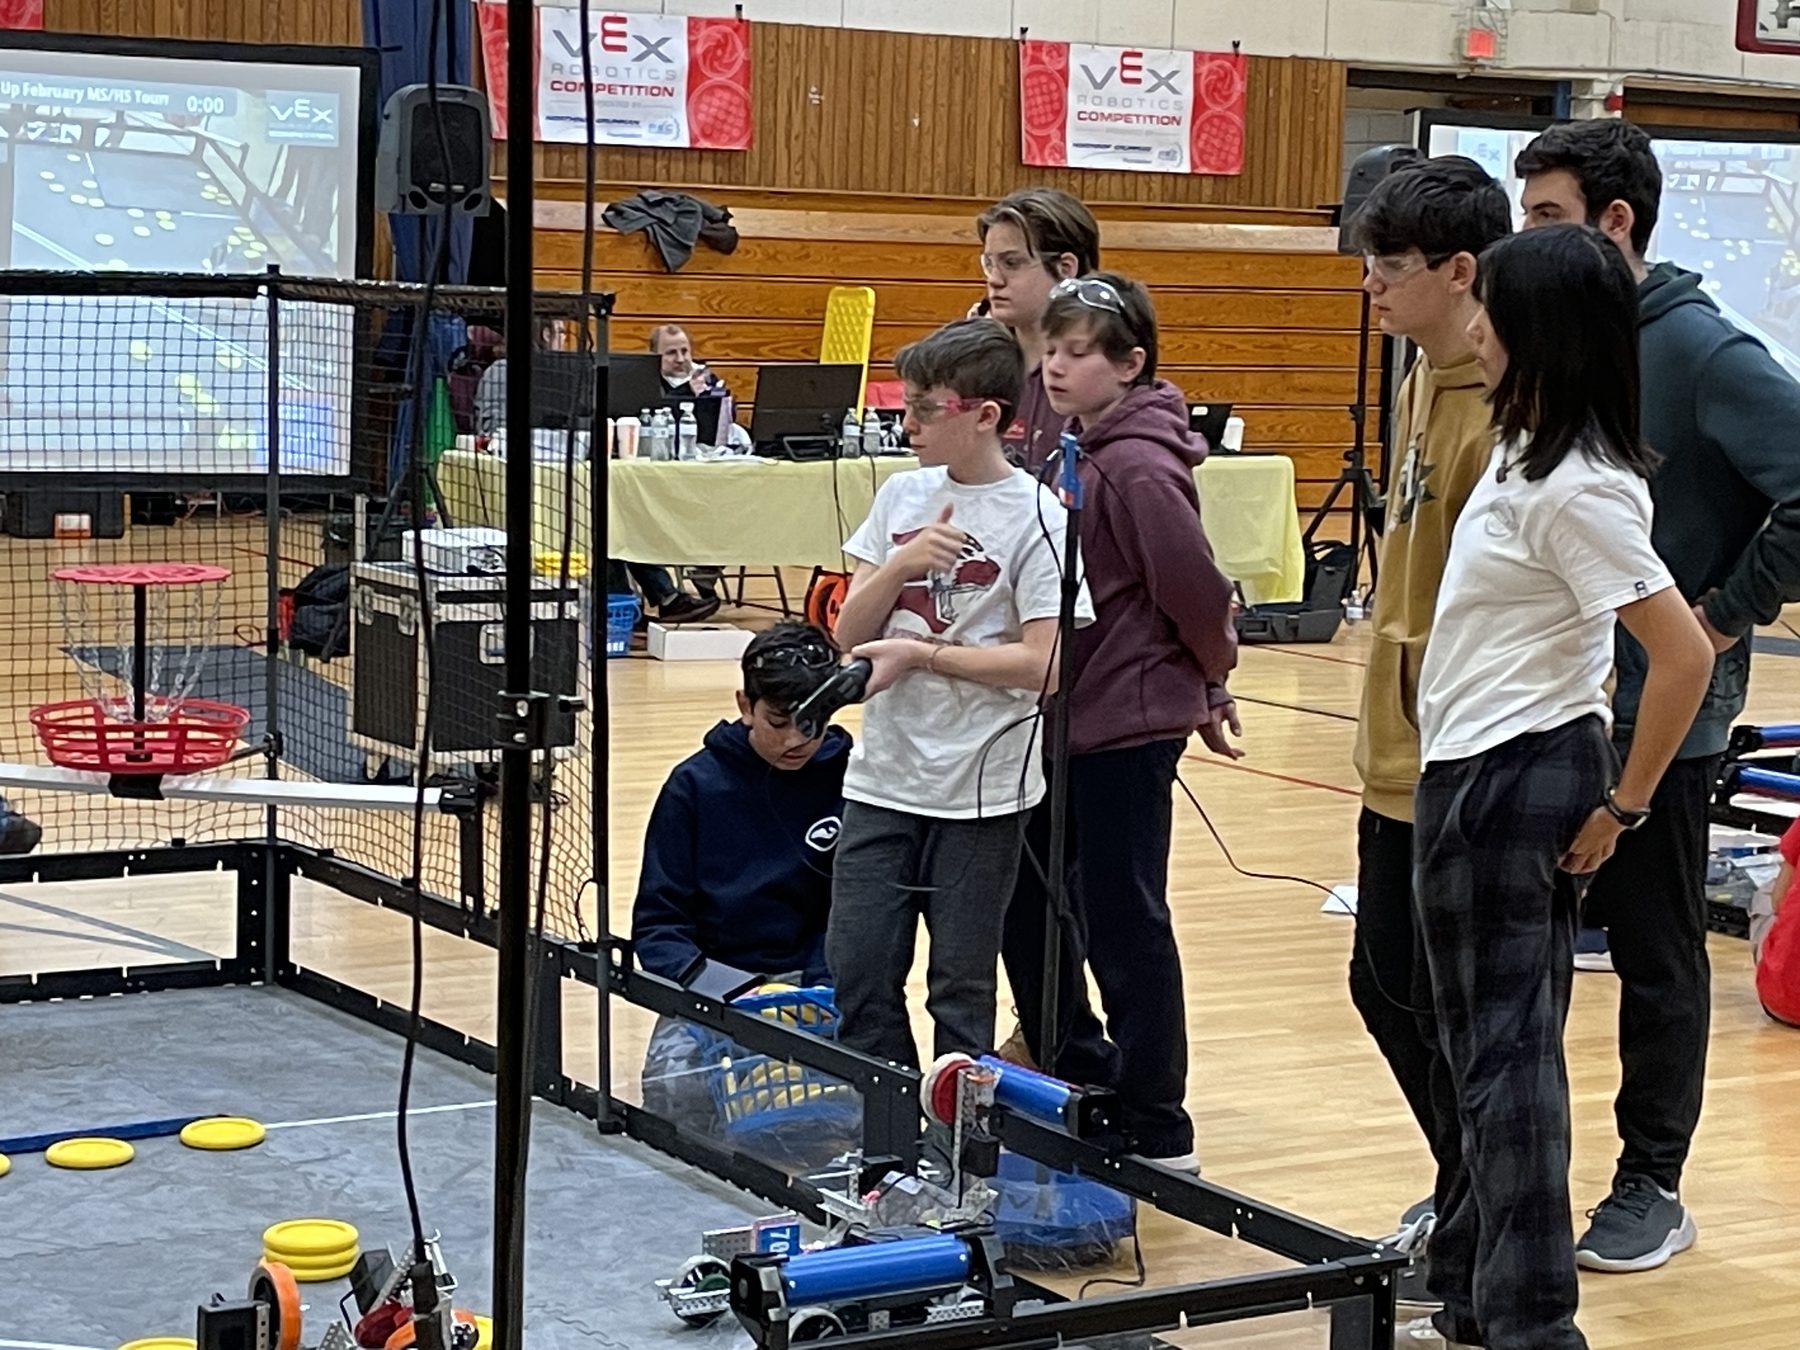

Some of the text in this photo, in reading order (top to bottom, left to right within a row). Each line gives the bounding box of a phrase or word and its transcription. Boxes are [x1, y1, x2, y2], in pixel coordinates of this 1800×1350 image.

[553, 16, 673, 63] VEX
[552, 62, 678, 81] ROBOTICS
[1080, 51, 1182, 95] VEX
[1, 81, 20, 98] Up
[22, 82, 84, 104] February
[87, 87, 132, 103] MS/HS
[1077, 94, 1184, 111] ROBOTICS
[187, 96, 224, 113] 0:00
[269, 98, 333, 124] VEX
[1077, 111, 1182, 126] COMPETITION
